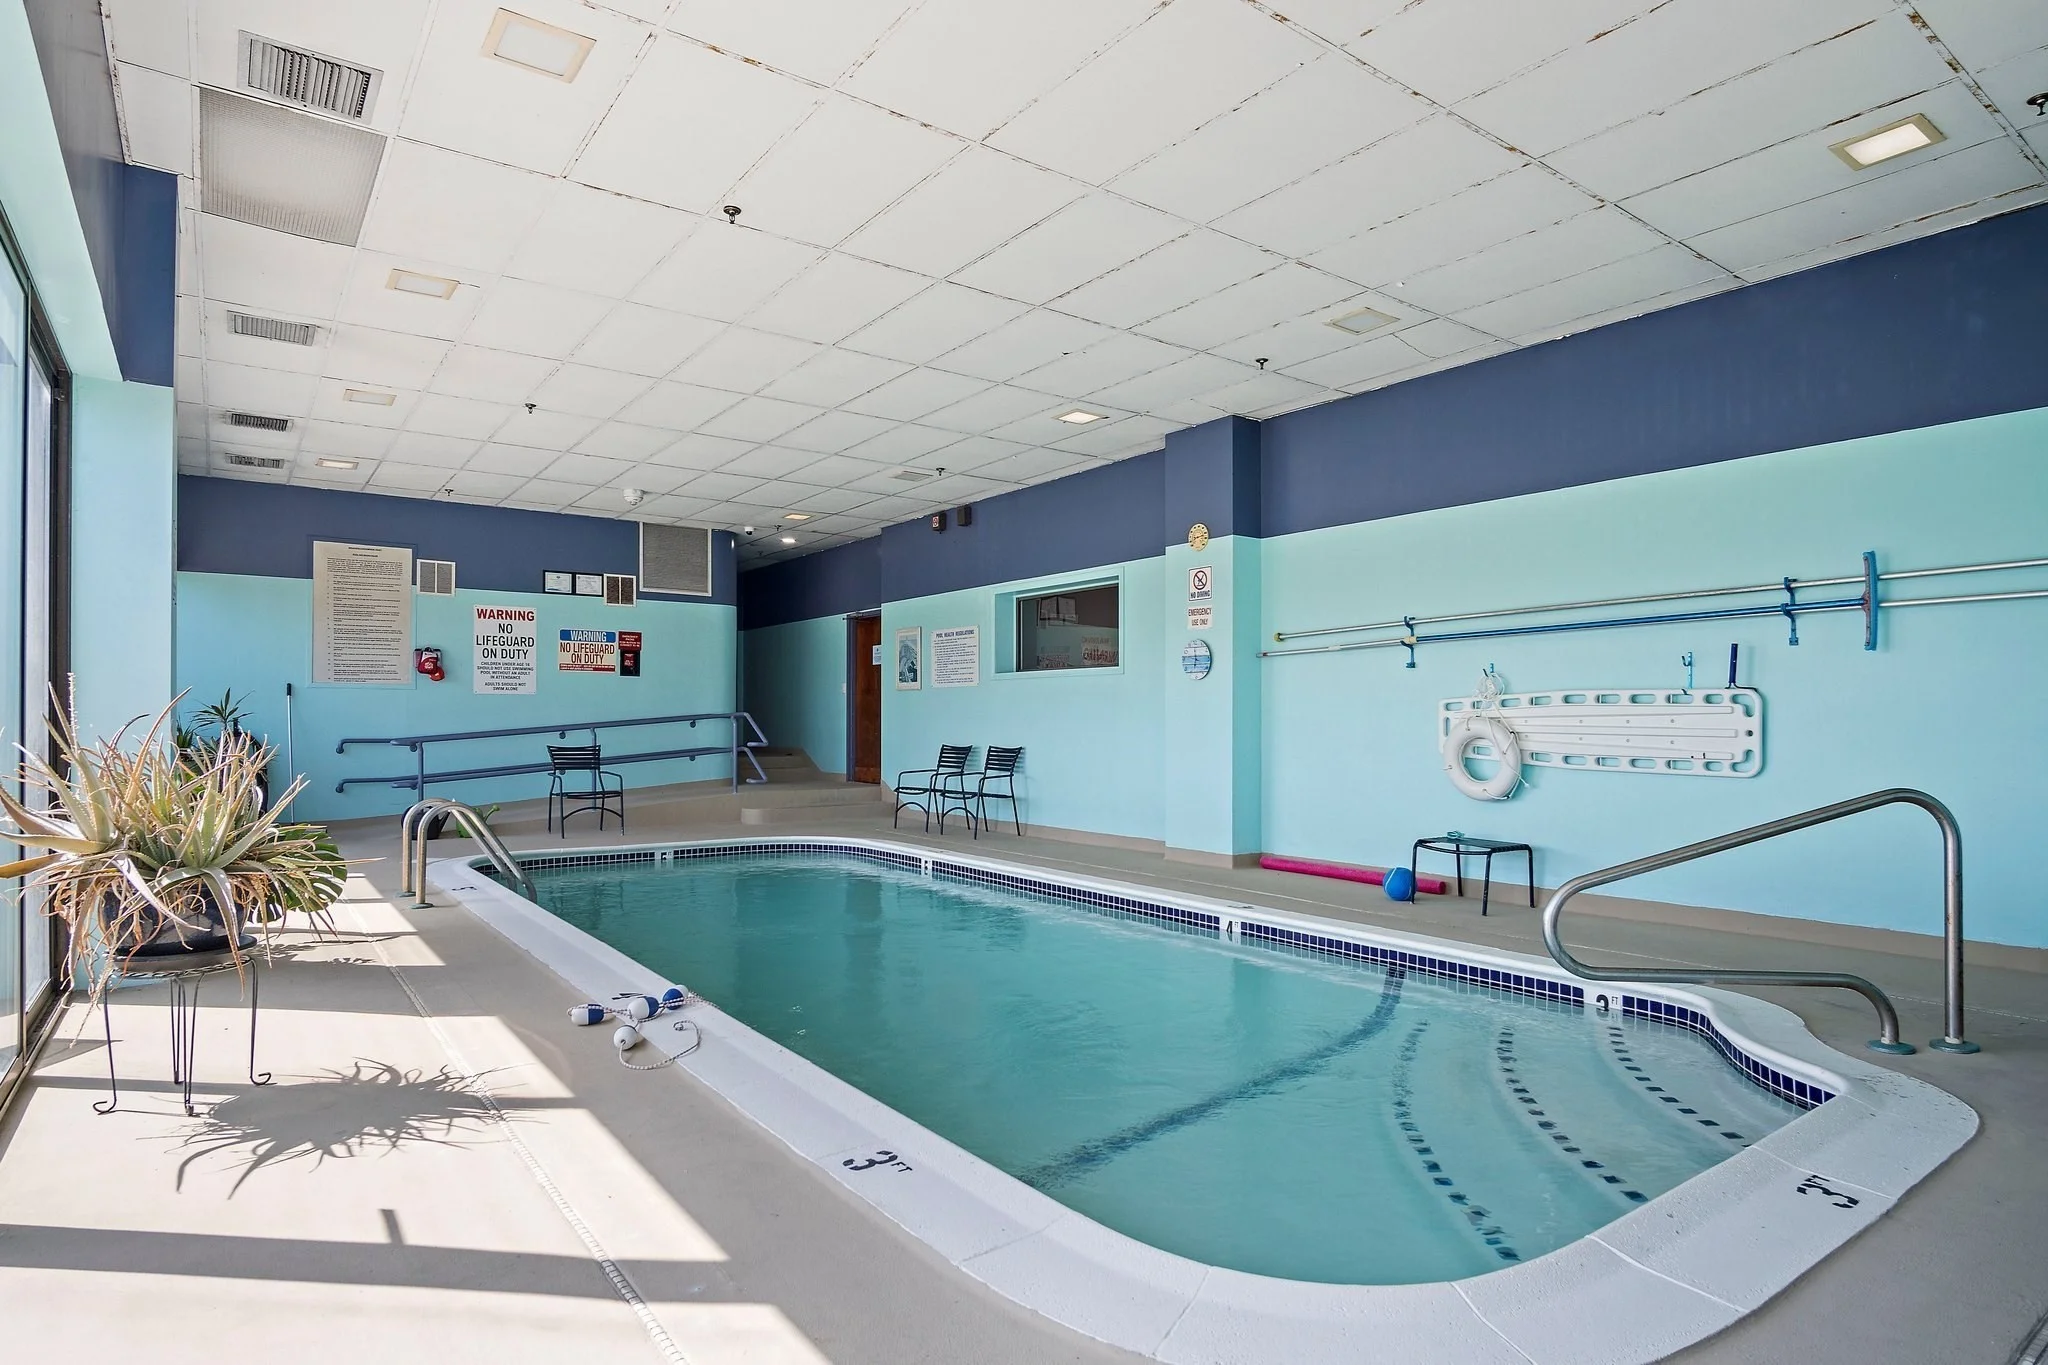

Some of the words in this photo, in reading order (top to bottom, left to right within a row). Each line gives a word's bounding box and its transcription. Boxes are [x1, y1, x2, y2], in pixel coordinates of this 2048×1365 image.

[1197, 590, 1210, 598] DIVING
[476, 608, 535, 621] WARNING
[1188, 608, 1211, 616] EMERGENCY
[498, 623, 513, 634] NO
[476, 635, 535, 647] LIFEGUARD
[570, 630, 607, 642] WARNING
[482, 648, 497, 659] ON
[501, 649, 528, 660] DUTY
[560, 642, 571, 652] NO
[573, 643, 615, 654] LIFEGUARD
[571, 653, 582, 664] ON
[584, 654, 604, 664] DUTY
[1611, 996, 1618, 1005] FT
[842, 1150, 898, 1171] 3
[1796, 1183, 1859, 1209] 3
